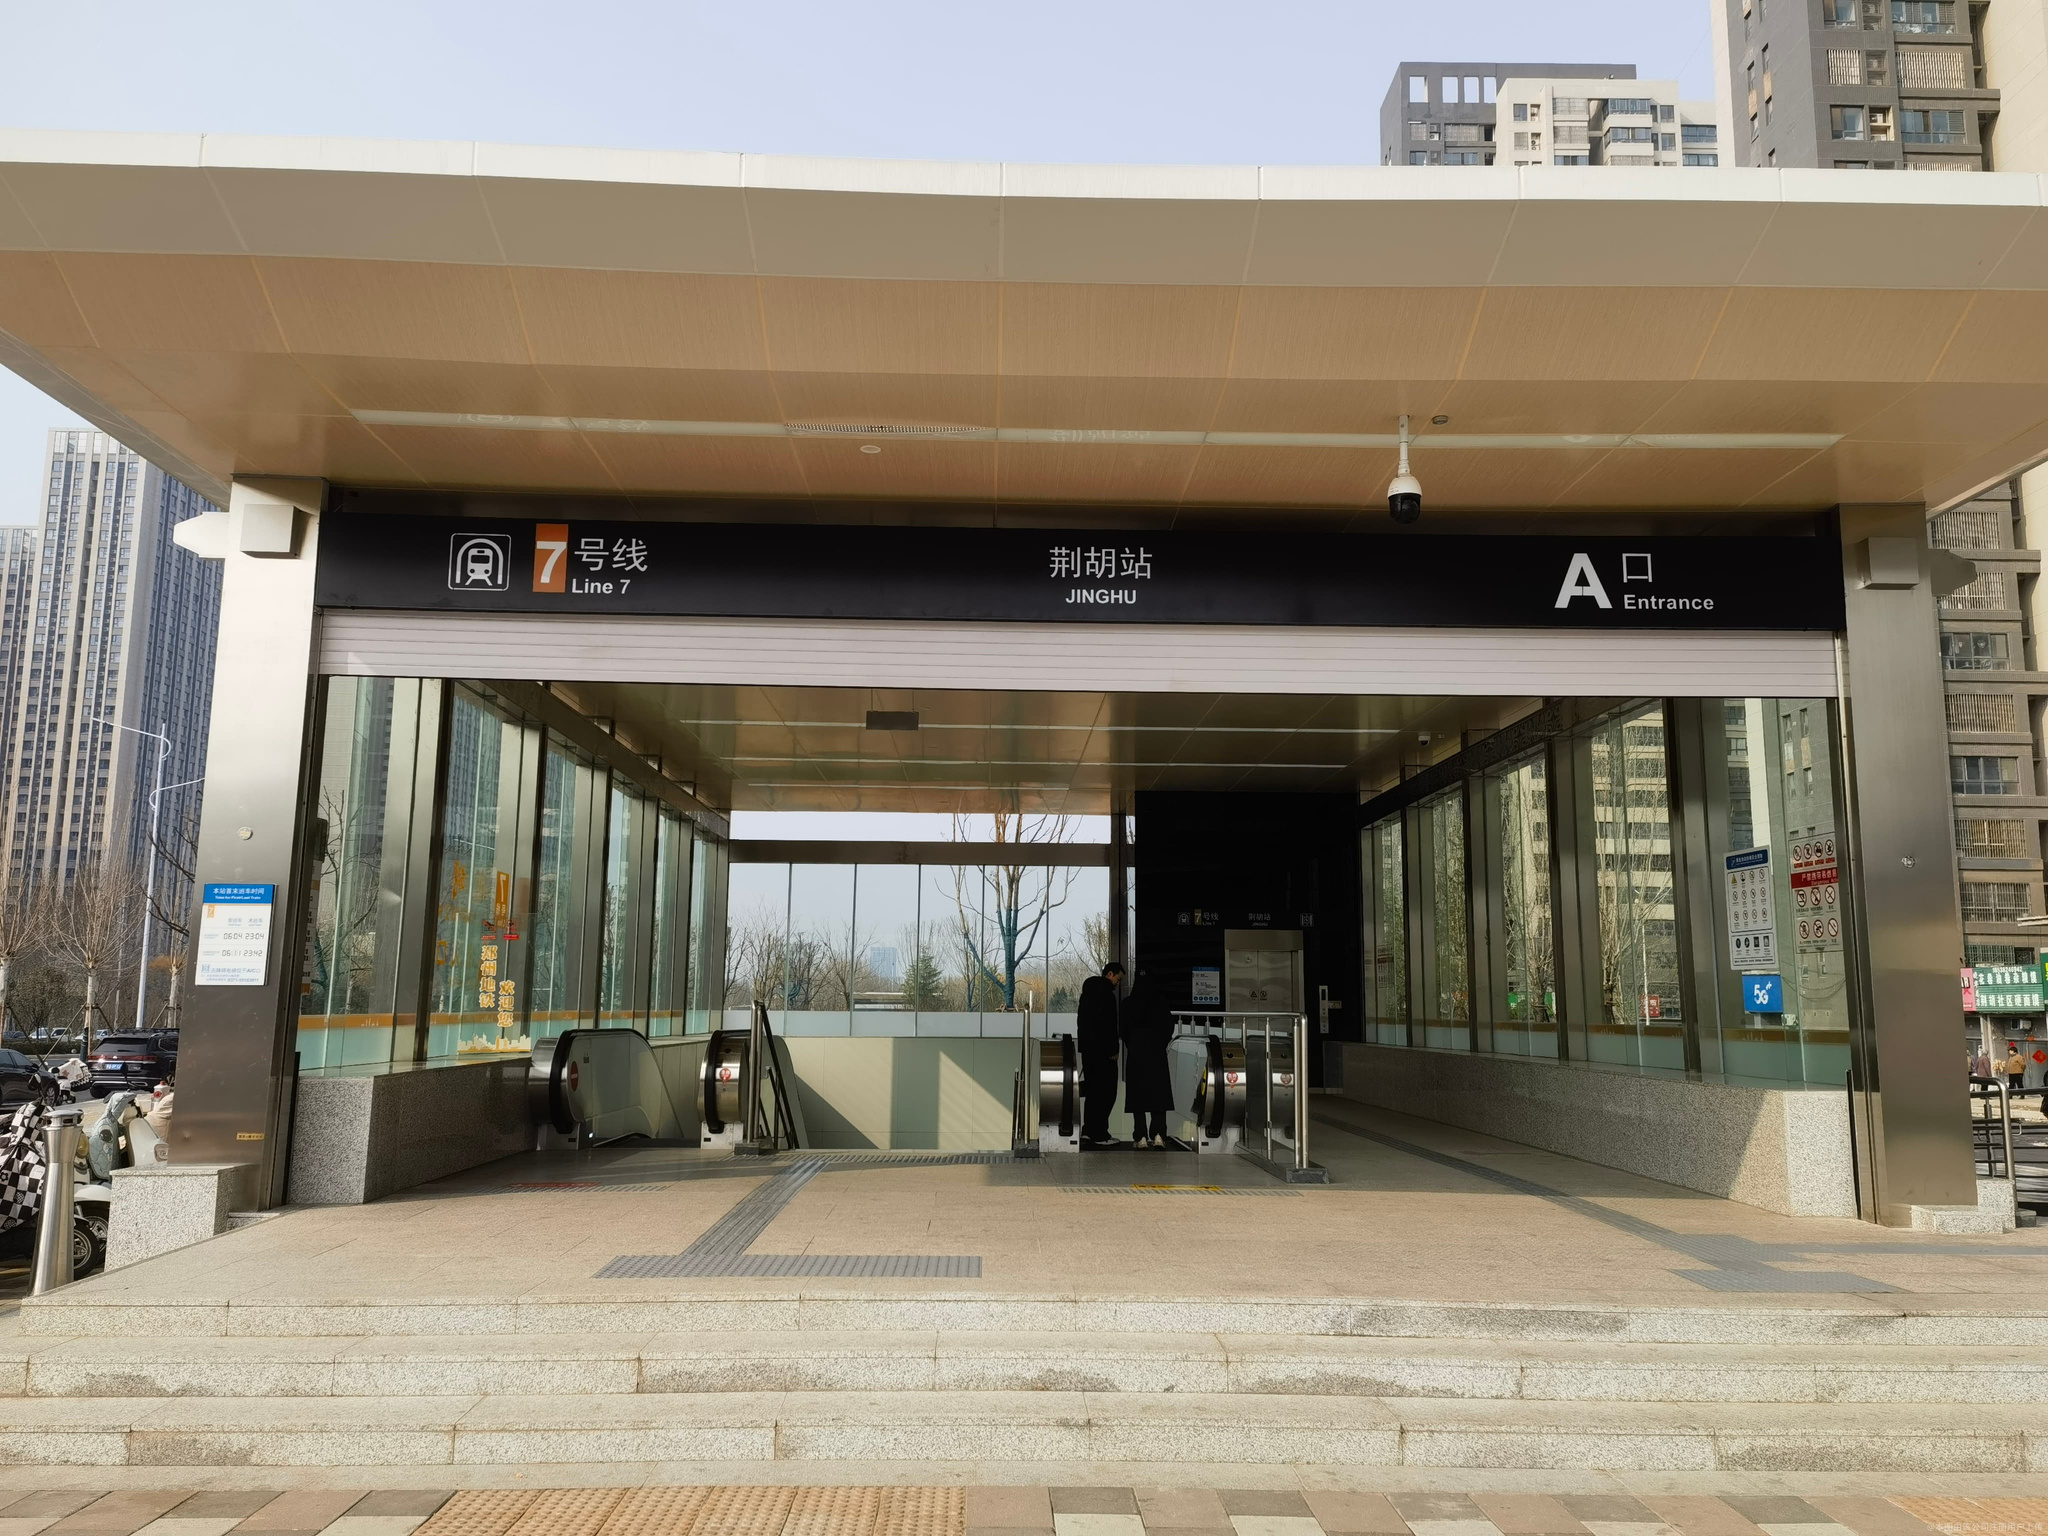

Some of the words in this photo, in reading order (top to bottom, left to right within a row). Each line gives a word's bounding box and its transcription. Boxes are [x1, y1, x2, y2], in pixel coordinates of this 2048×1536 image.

[536, 541, 567, 584] 7
[574, 538, 648, 572] 号线
[1049, 546, 1153, 579] 荆胡站
[1622, 553, 1653, 583] 口
[571, 578, 614, 594] Line
[620, 579, 631, 594] 7
[1065, 589, 1137, 604] JINGHU
[1554, 553, 1613, 609] A
[1623, 594, 1714, 610] Entrance
[479, 945, 498, 1008] 郑州地铁
[497, 980, 516, 1028] 欢迎您
